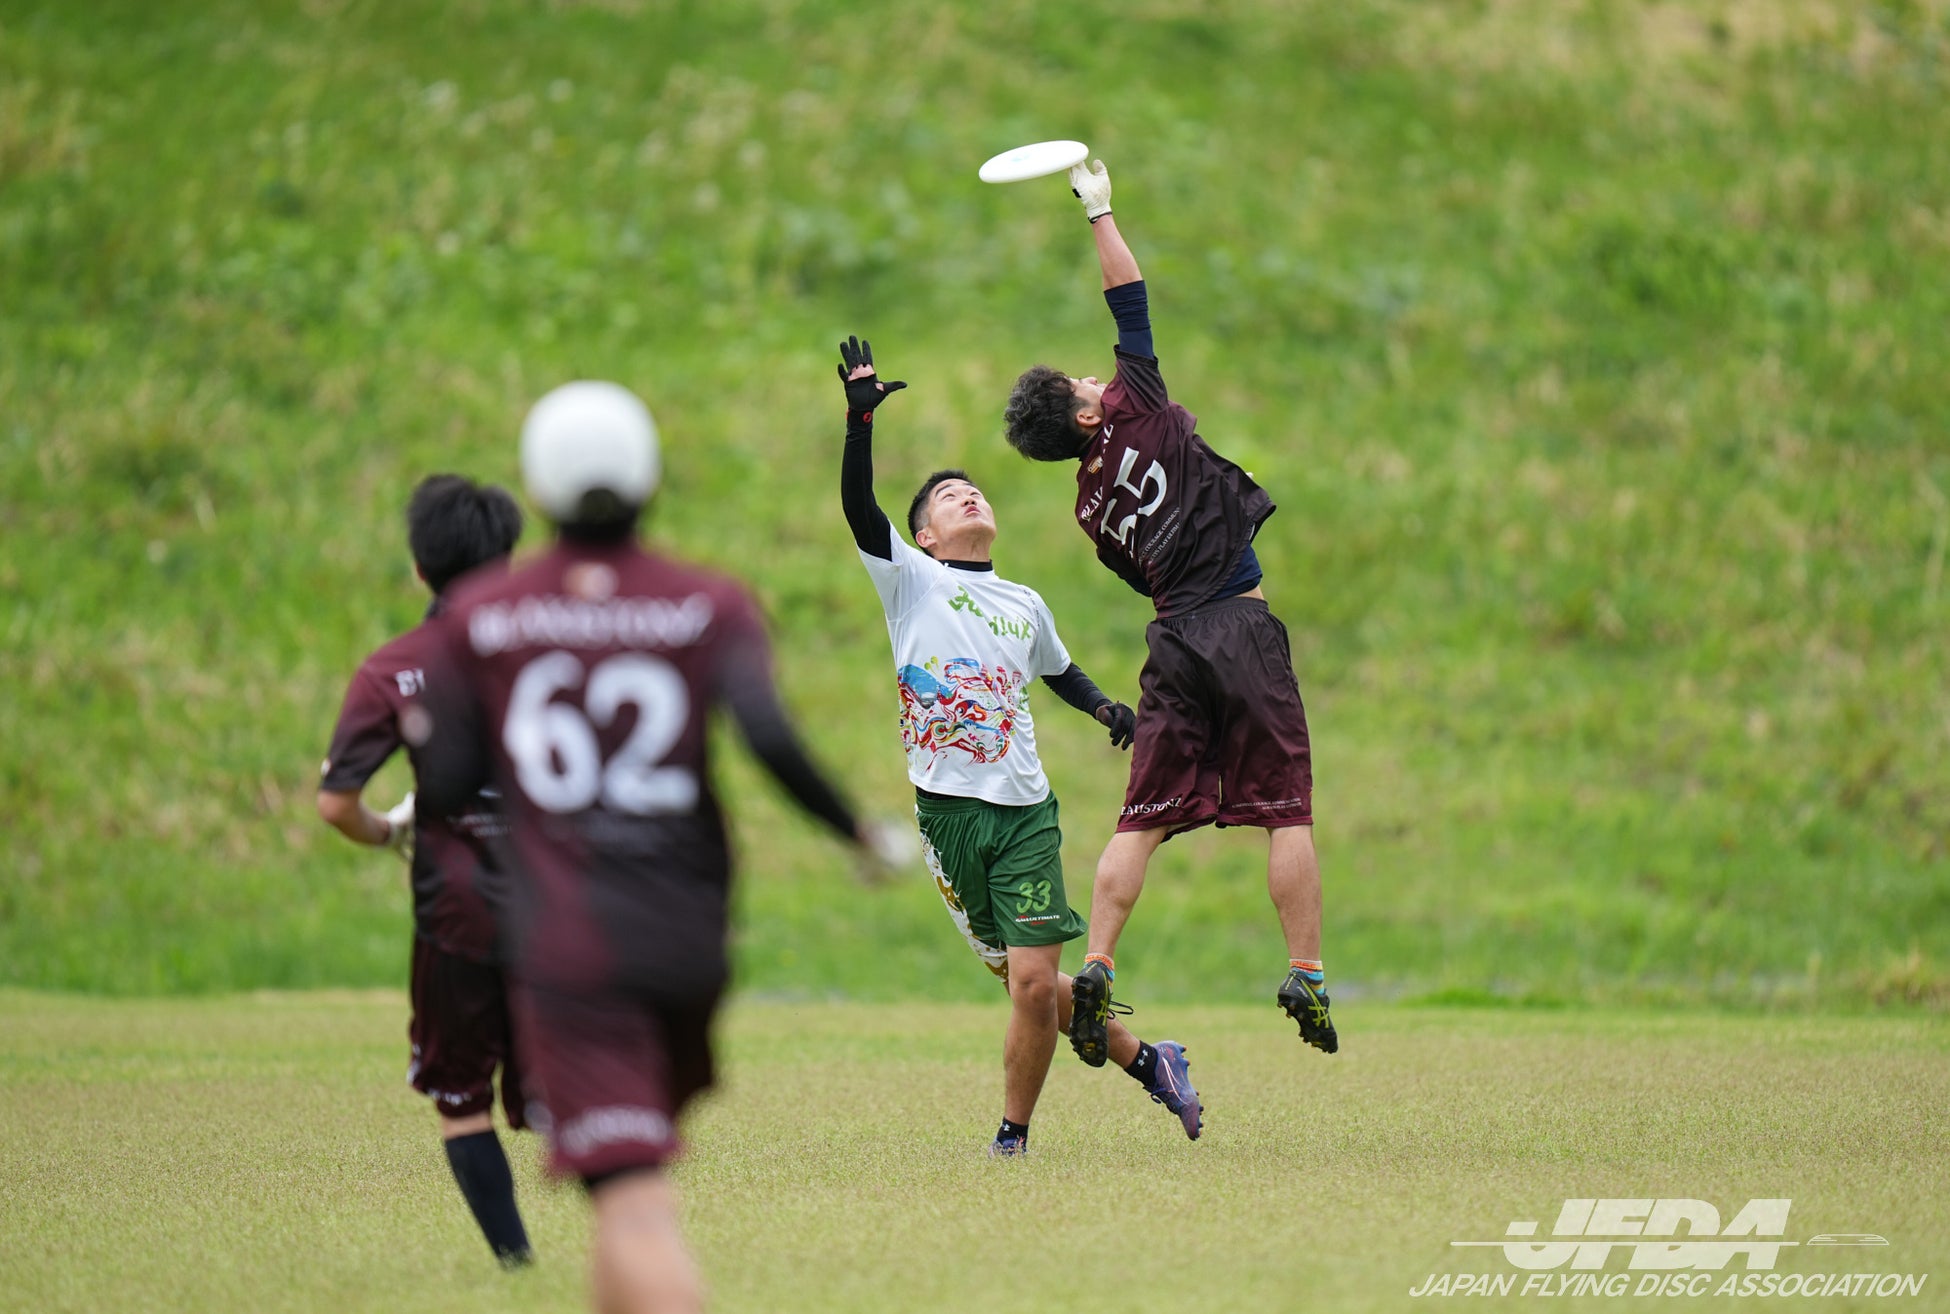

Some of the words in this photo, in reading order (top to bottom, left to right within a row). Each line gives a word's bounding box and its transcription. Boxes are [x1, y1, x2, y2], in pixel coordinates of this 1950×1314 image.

[1101, 446, 1167, 558] 55
[504, 650, 699, 814] 62
[1016, 880, 1051, 913] 33
